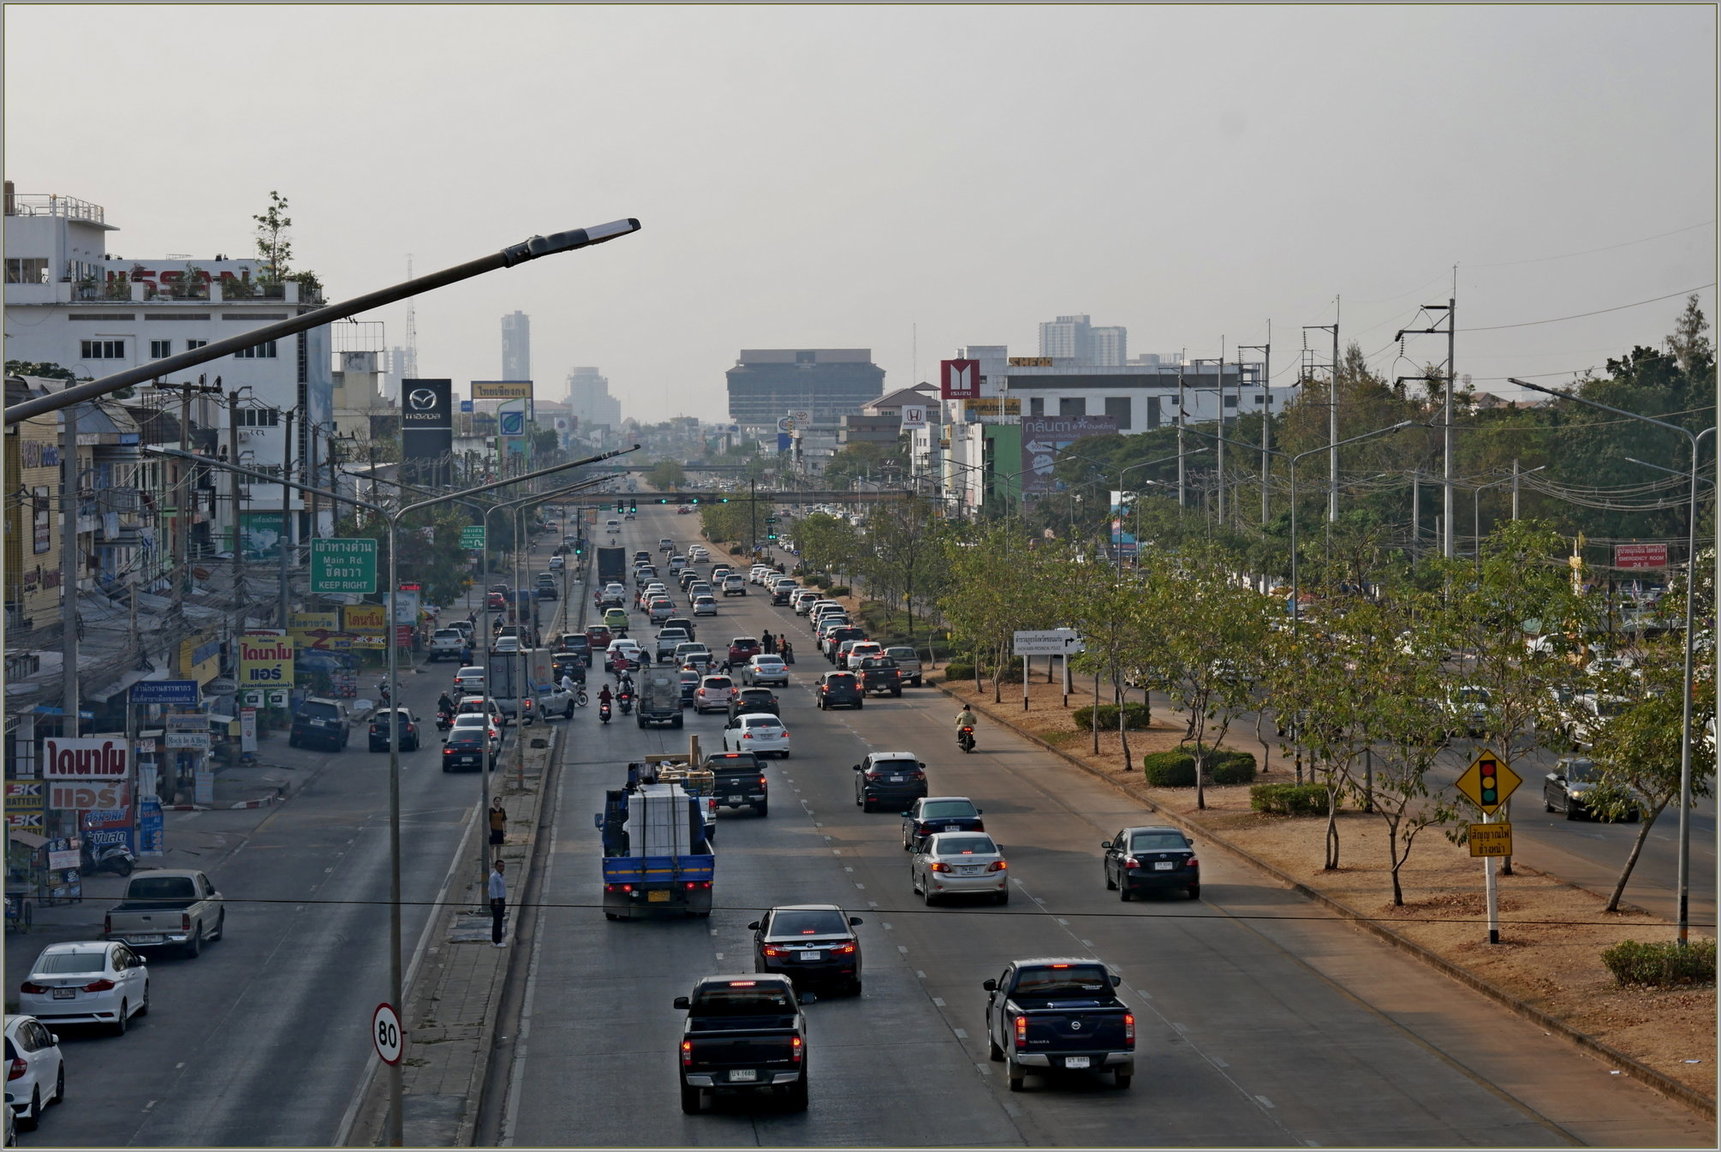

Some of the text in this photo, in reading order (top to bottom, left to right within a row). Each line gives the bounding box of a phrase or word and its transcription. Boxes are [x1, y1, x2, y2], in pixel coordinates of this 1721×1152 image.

[315, 539, 372, 553] เข้าทางด่วน
[323, 556, 344, 565] Main
[326, 564, 361, 577] ชิดขวา
[319, 581, 367, 589] KEEP RIGHT
[347, 611, 383, 626] ไดนาโม
[241, 642, 292, 661] ไดนาโม
[250, 664, 282, 681] แอร์
[48, 741, 126, 775] ไดนาโม
[8, 784, 41, 797] 3K
[53, 783, 116, 809] แอร์
[6, 798, 42, 806] BATTERY
[9, 814, 42, 827] 3K
[1472, 827, 1509, 842] สัญญาณไฟ
[1479, 843, 1504, 854] ข้างหน้า
[379, 1020, 397, 1049] 80
